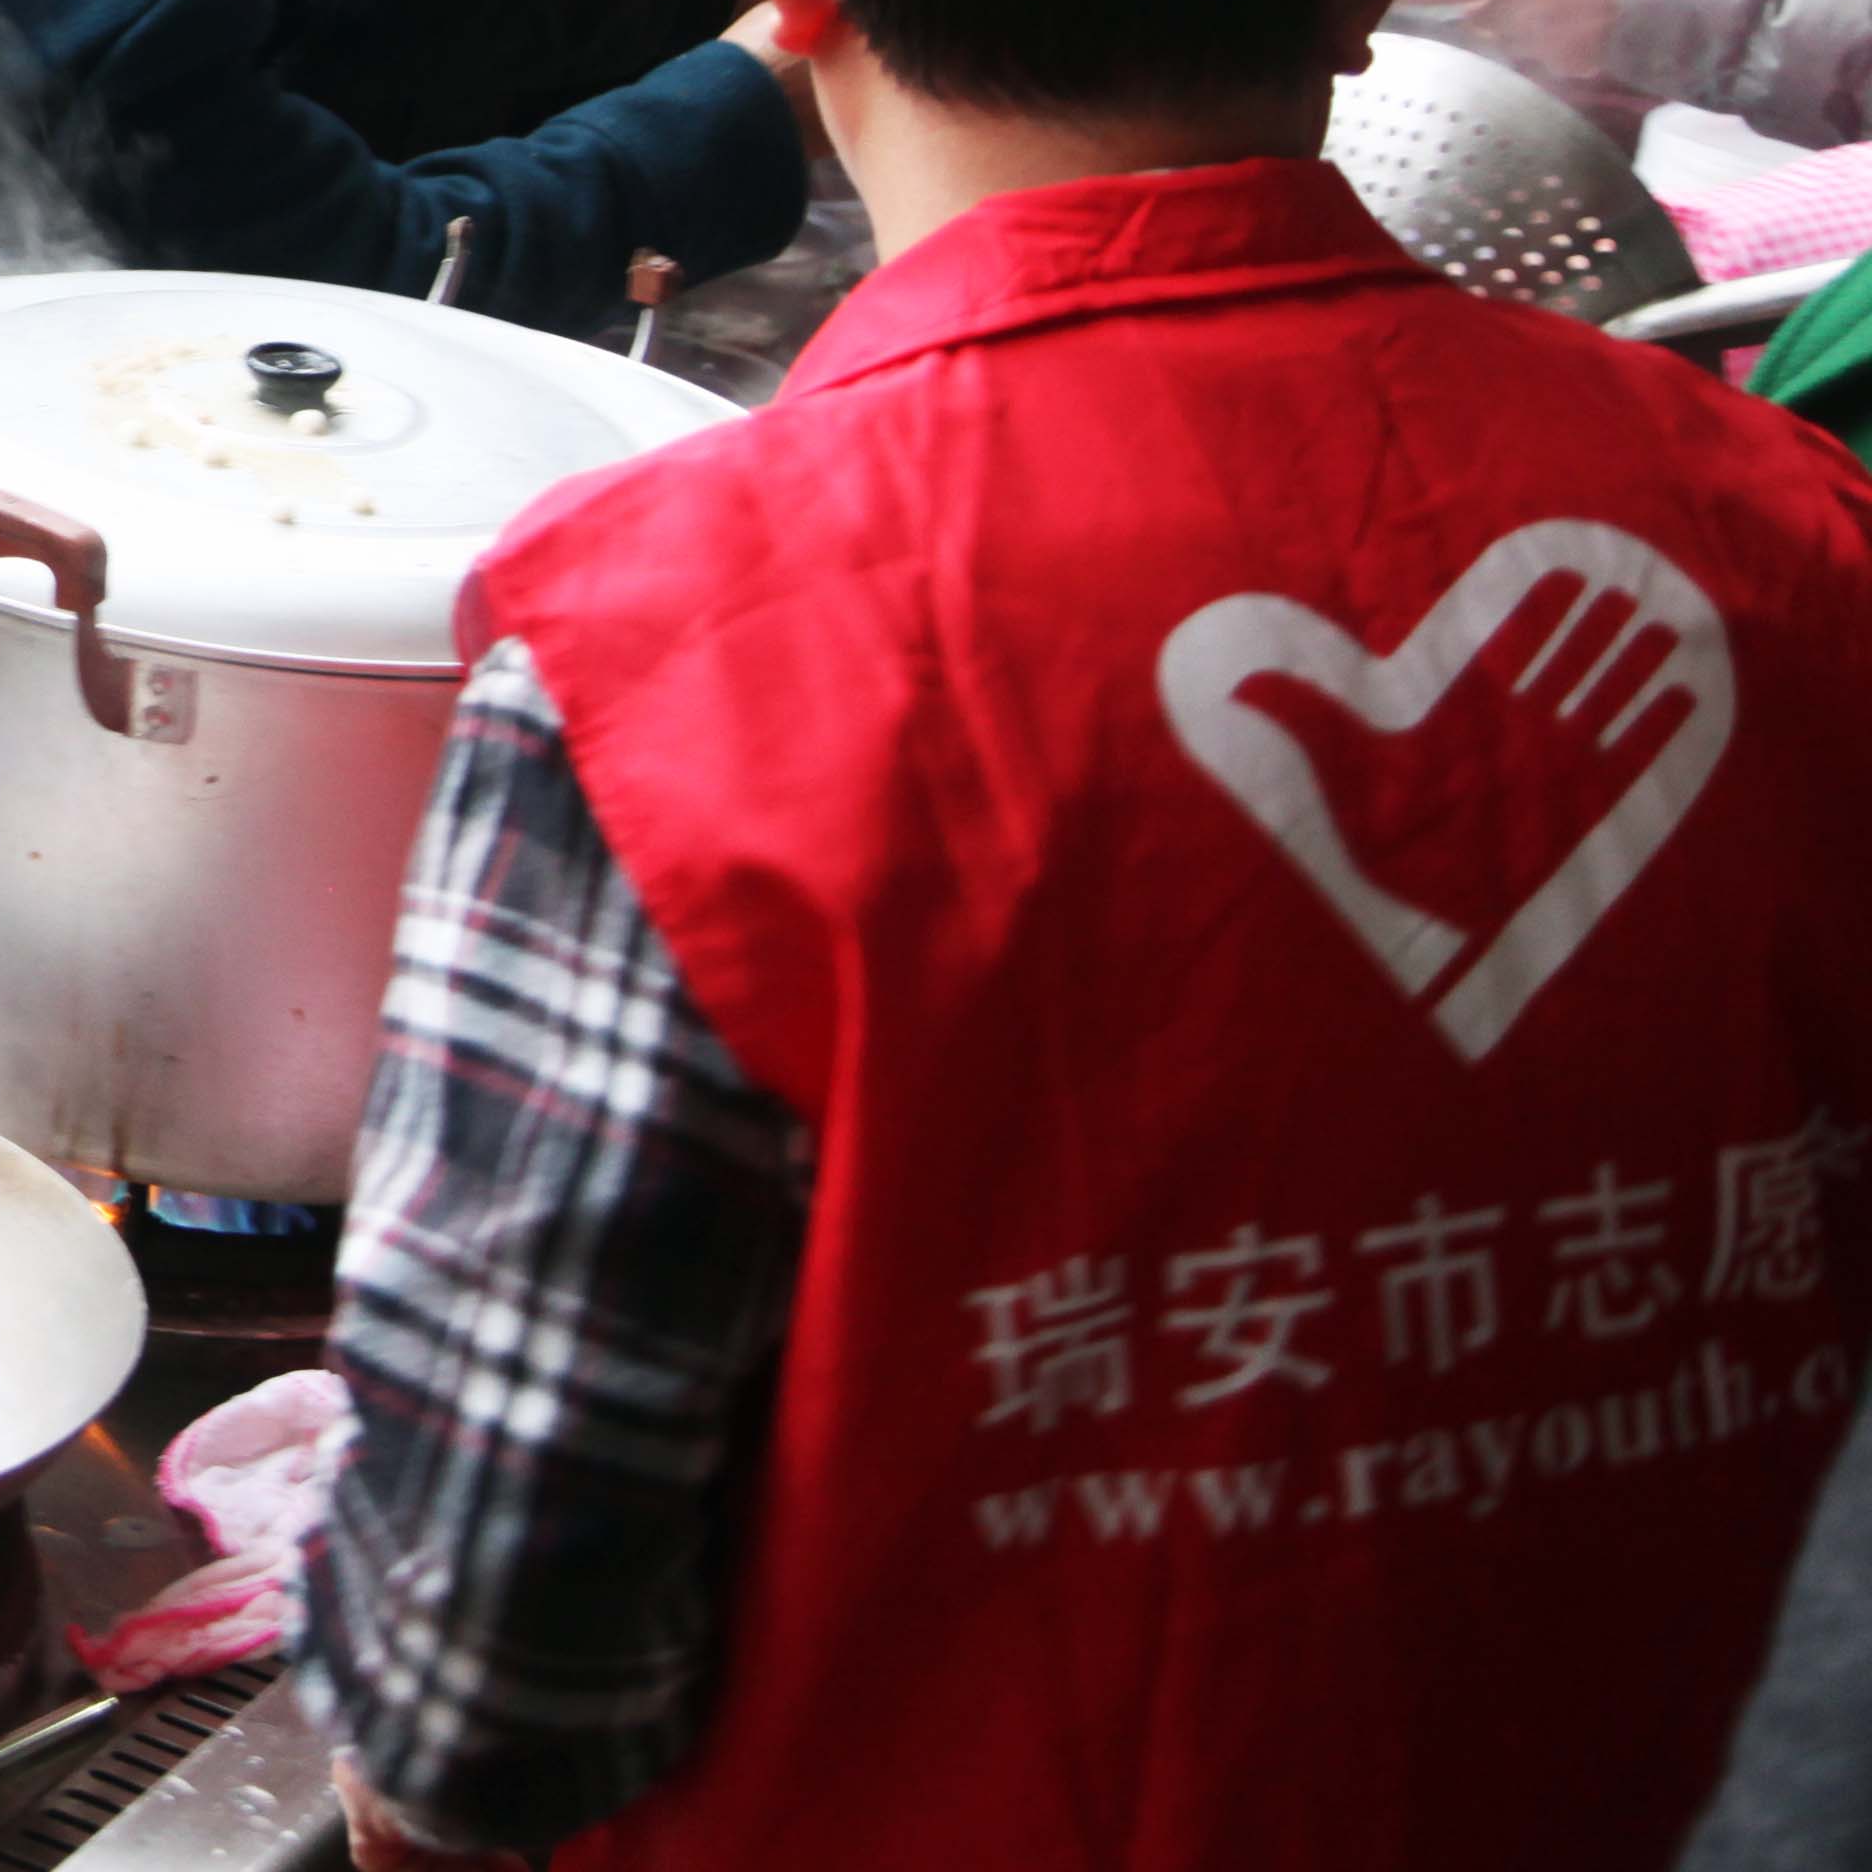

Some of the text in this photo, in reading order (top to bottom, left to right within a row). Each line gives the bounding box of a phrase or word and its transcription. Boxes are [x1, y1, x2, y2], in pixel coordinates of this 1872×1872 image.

[963, 1102, 1872, 1434] 瑞安市志愿
